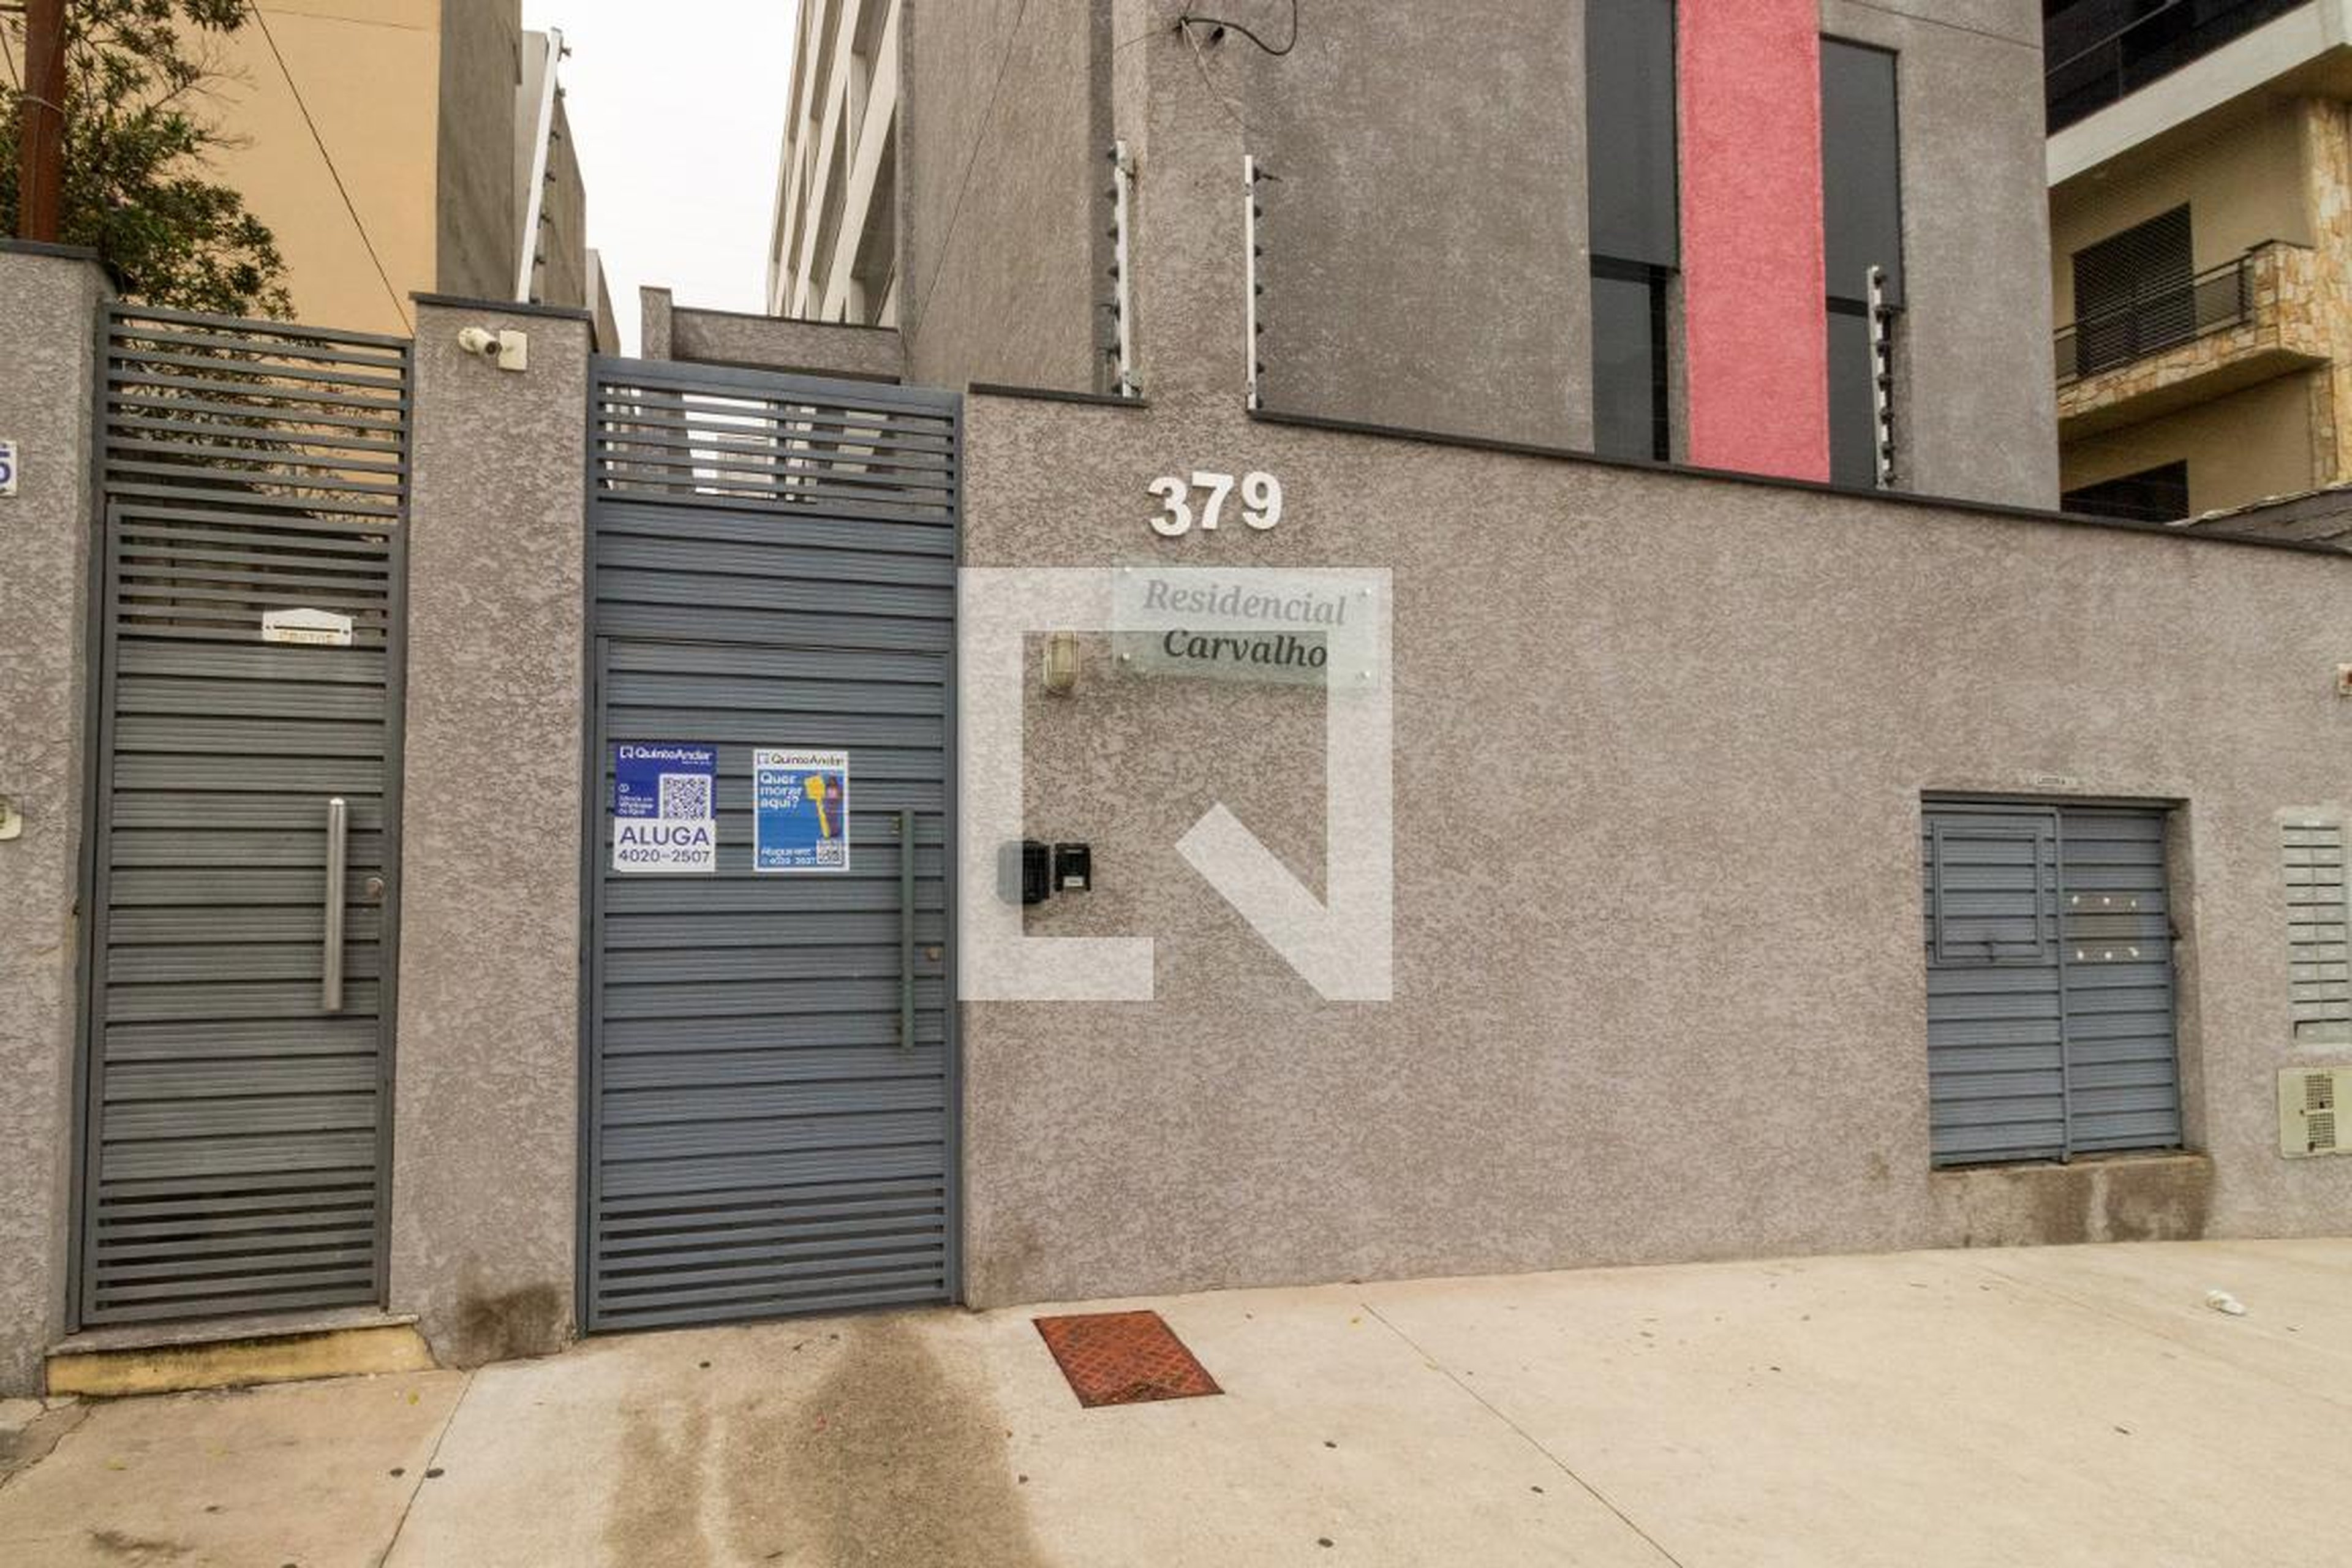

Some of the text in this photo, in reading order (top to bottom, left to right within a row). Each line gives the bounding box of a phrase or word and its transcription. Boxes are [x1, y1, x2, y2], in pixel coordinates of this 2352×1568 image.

[1147, 470, 1283, 536] 379
[1142, 579, 1347, 626] Residencial
[1164, 628, 1328, 668] Carvalho
[635, 745, 714, 760] QuintoAndar
[760, 771, 797, 785] Quer
[760, 786, 803, 796] morar
[760, 795, 799, 809] aqui?
[620, 826, 710, 845] ALUGA
[619, 849, 711, 862] 4020-2507
